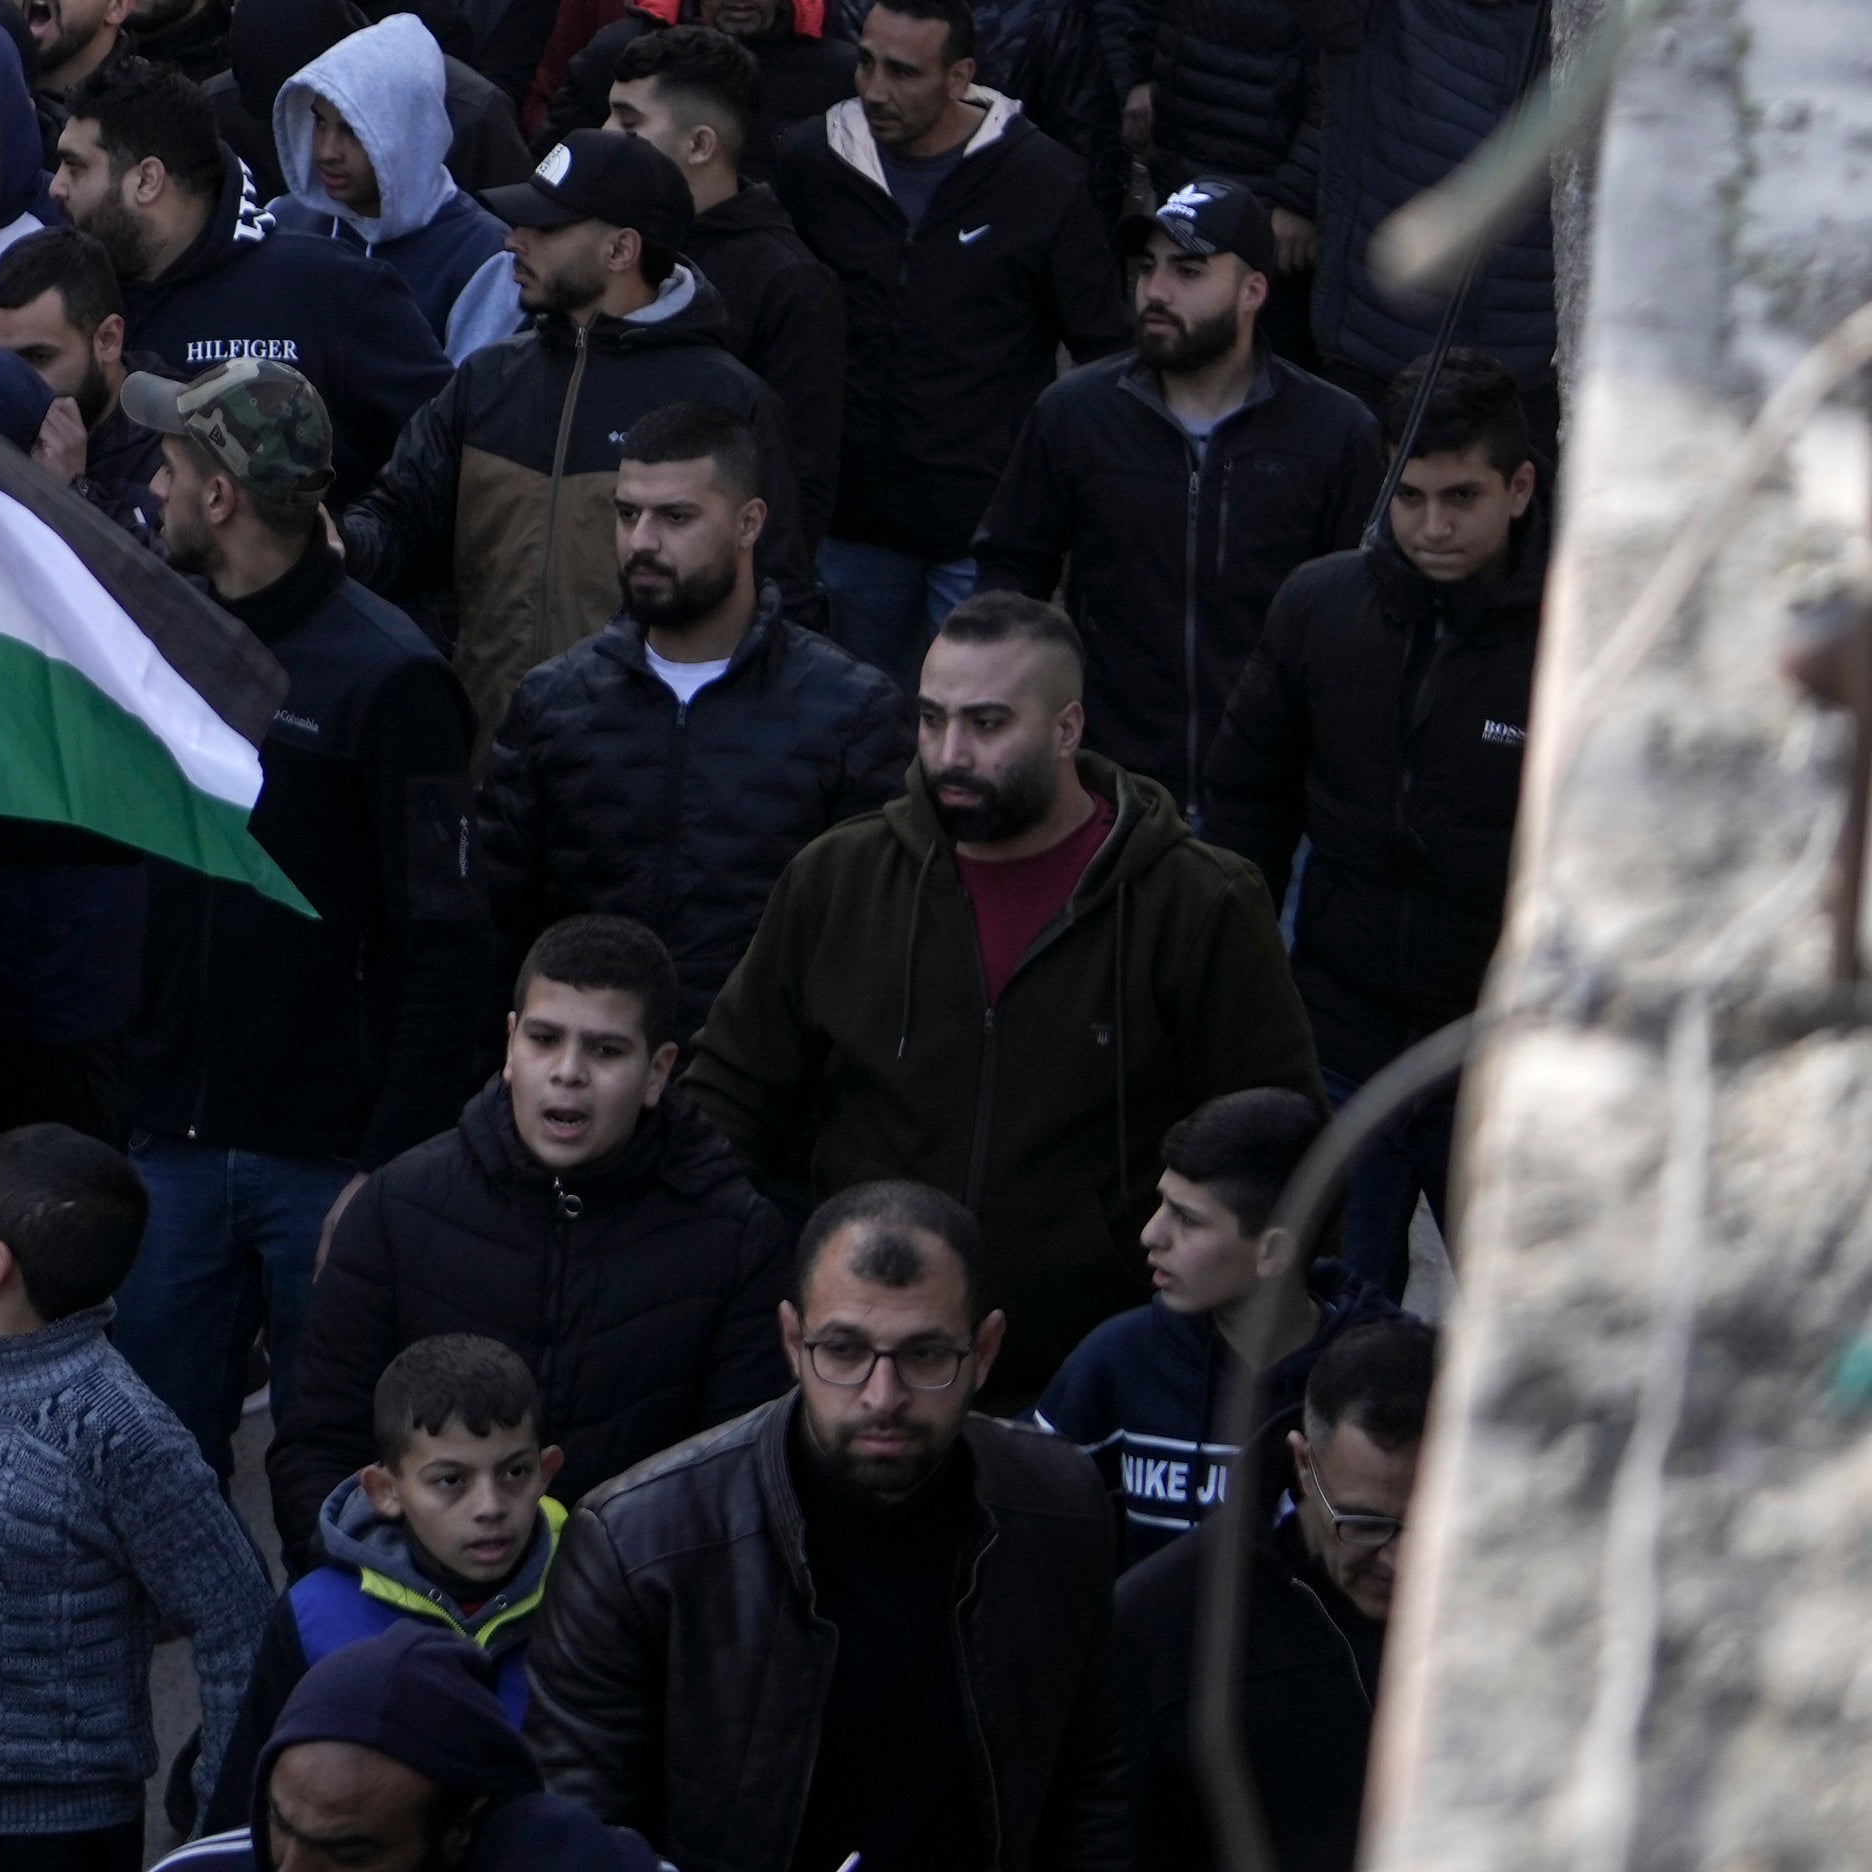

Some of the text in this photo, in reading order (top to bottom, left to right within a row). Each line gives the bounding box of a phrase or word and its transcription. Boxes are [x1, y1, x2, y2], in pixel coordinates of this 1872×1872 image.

[186, 338, 301, 362] HILFIGER
[280, 709, 320, 733] Columbia
[1120, 1451, 1189, 1503] NIKE
